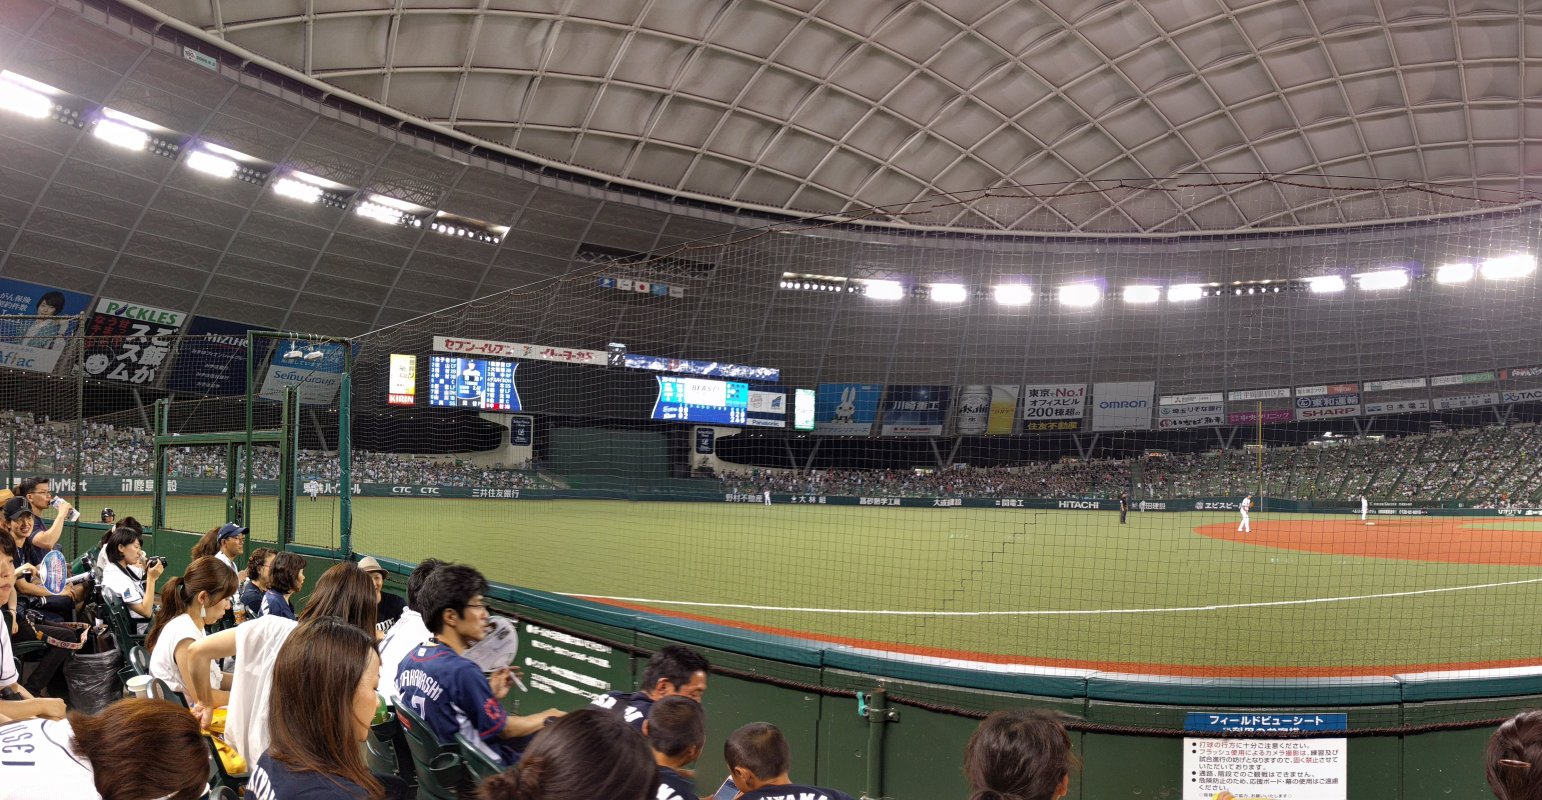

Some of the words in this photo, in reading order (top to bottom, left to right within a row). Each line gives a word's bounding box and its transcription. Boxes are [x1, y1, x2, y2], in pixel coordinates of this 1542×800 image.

[389, 394, 414, 404] KIRIN
[892, 401, 940, 411] 川崎重工
[1172, 405, 1222, 414] 埼玉りそな銀行
[1302, 407, 1355, 417] SHARP
[1027, 420, 1078, 431] 住友不動産
[134, 479, 178, 492] 鹿島設
[393, 486, 412, 494] CTC
[472, 488, 520, 499] 三井住友銀行
[725, 493, 763, 503] 野村不動産
[1058, 500, 1100, 509] HITACHI
[400, 668, 444, 702] AKAHASHI
[1209, 715, 1324, 726] フィールドビューシート
[1199, 741, 1310, 750] 打球の行方に十分ご注意ください。
